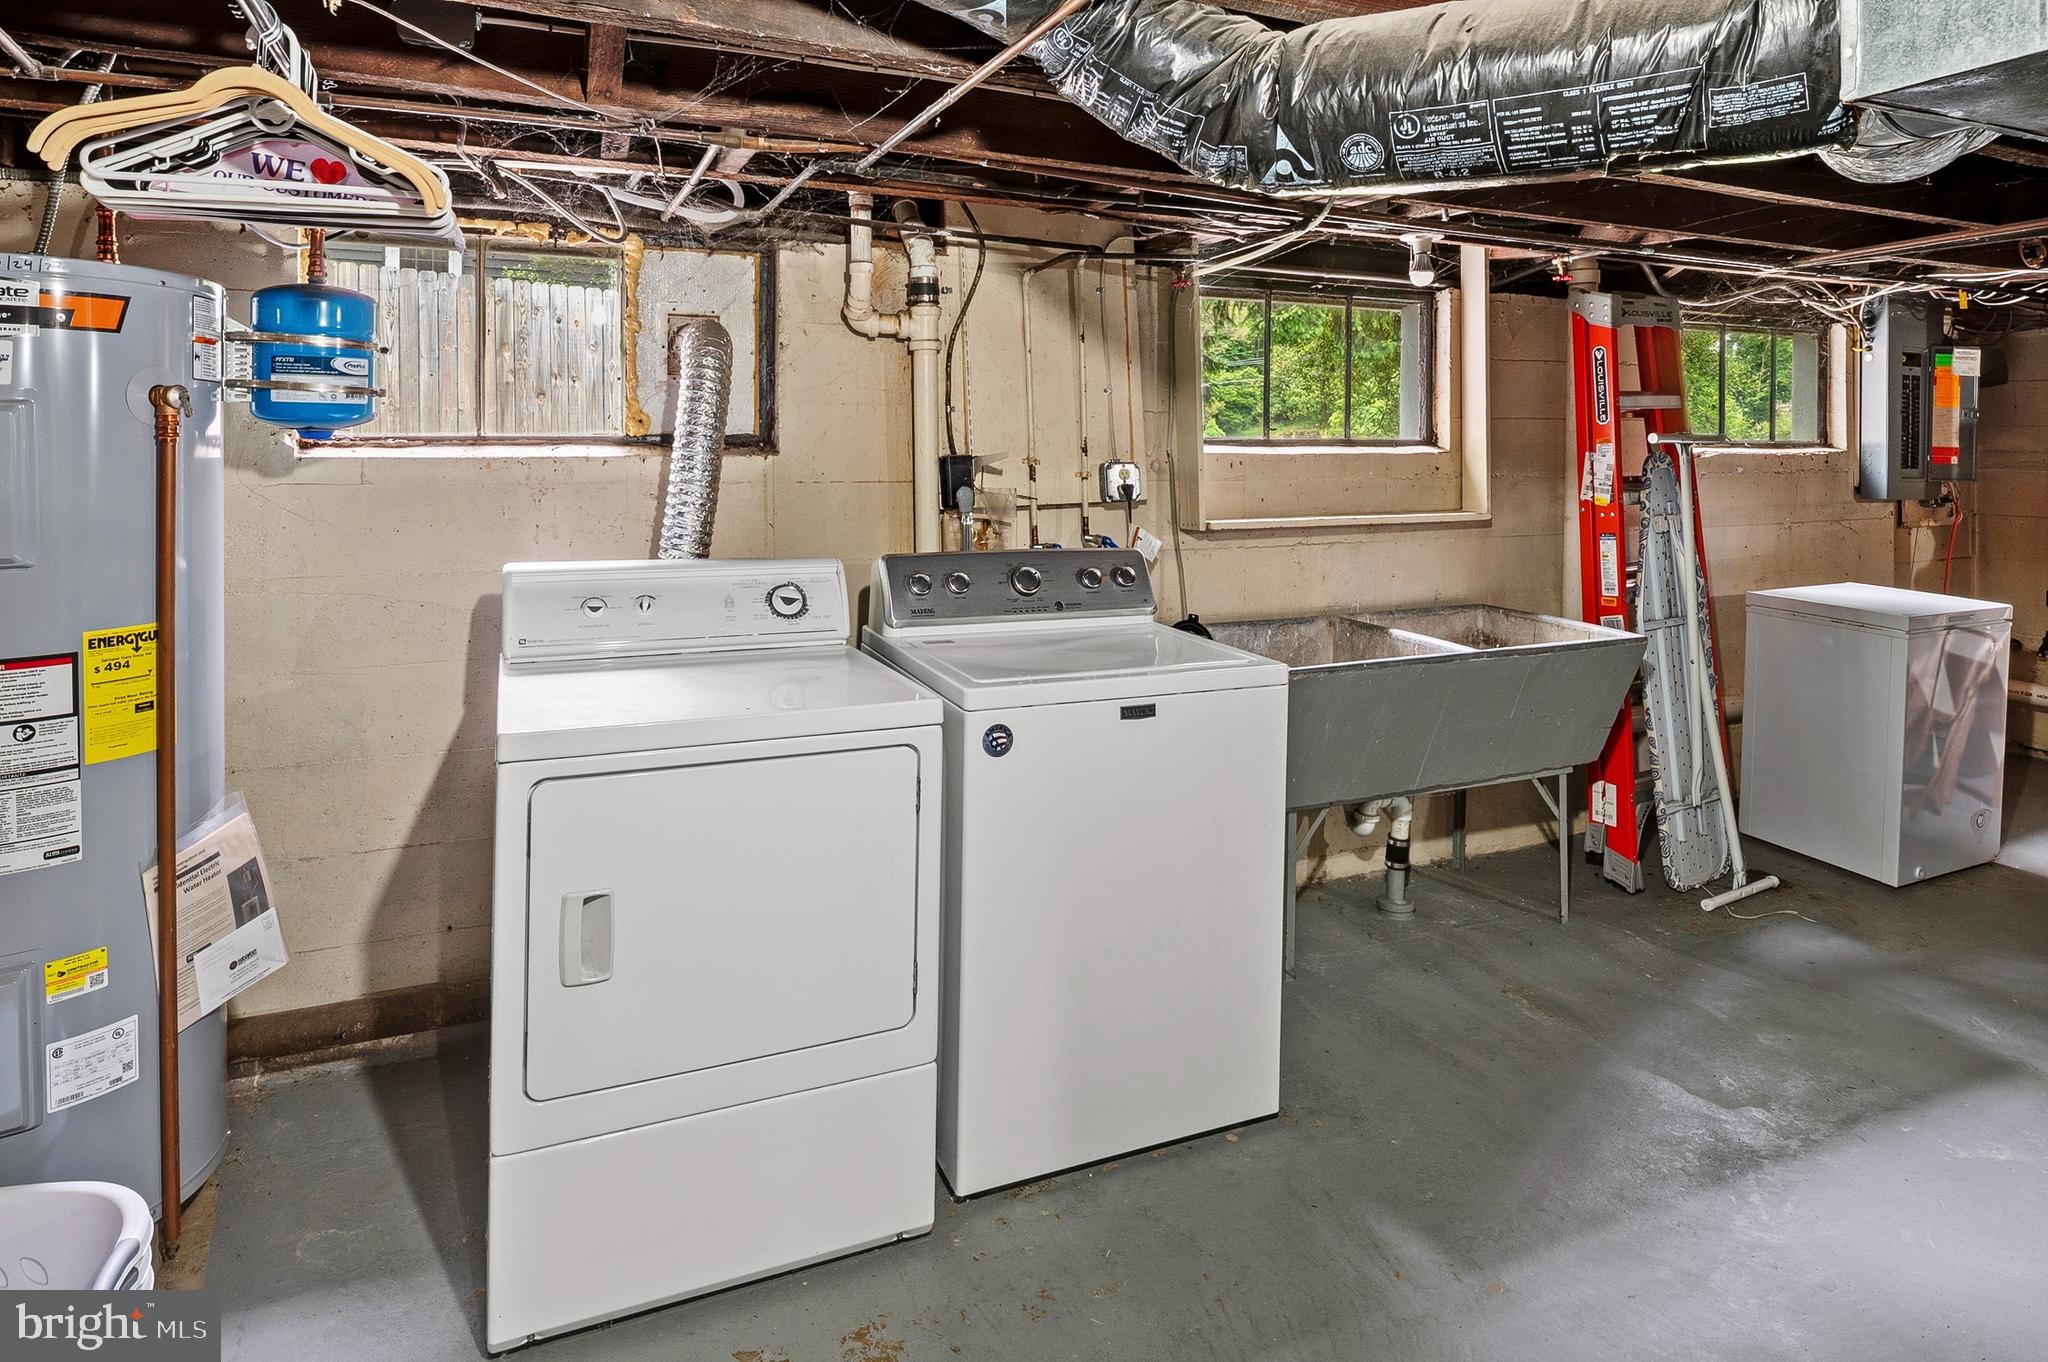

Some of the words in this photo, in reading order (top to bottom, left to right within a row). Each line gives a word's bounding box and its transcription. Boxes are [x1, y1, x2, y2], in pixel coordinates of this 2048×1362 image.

[1563, 89, 1580, 97] CLASS
[251, 152, 306, 182] WE
[1433, 168, 1470, 179] R-4.2
[1628, 309, 1673, 318] LOUISVILLE
[1597, 360, 1606, 421] LOUISVILLE
[88, 628, 159, 650] ENERGYGU
[94, 666, 101, 674] $
[104, 660, 131, 672] 494
[183, 880, 203, 894] Water
[203, 869, 222, 883] Heater
